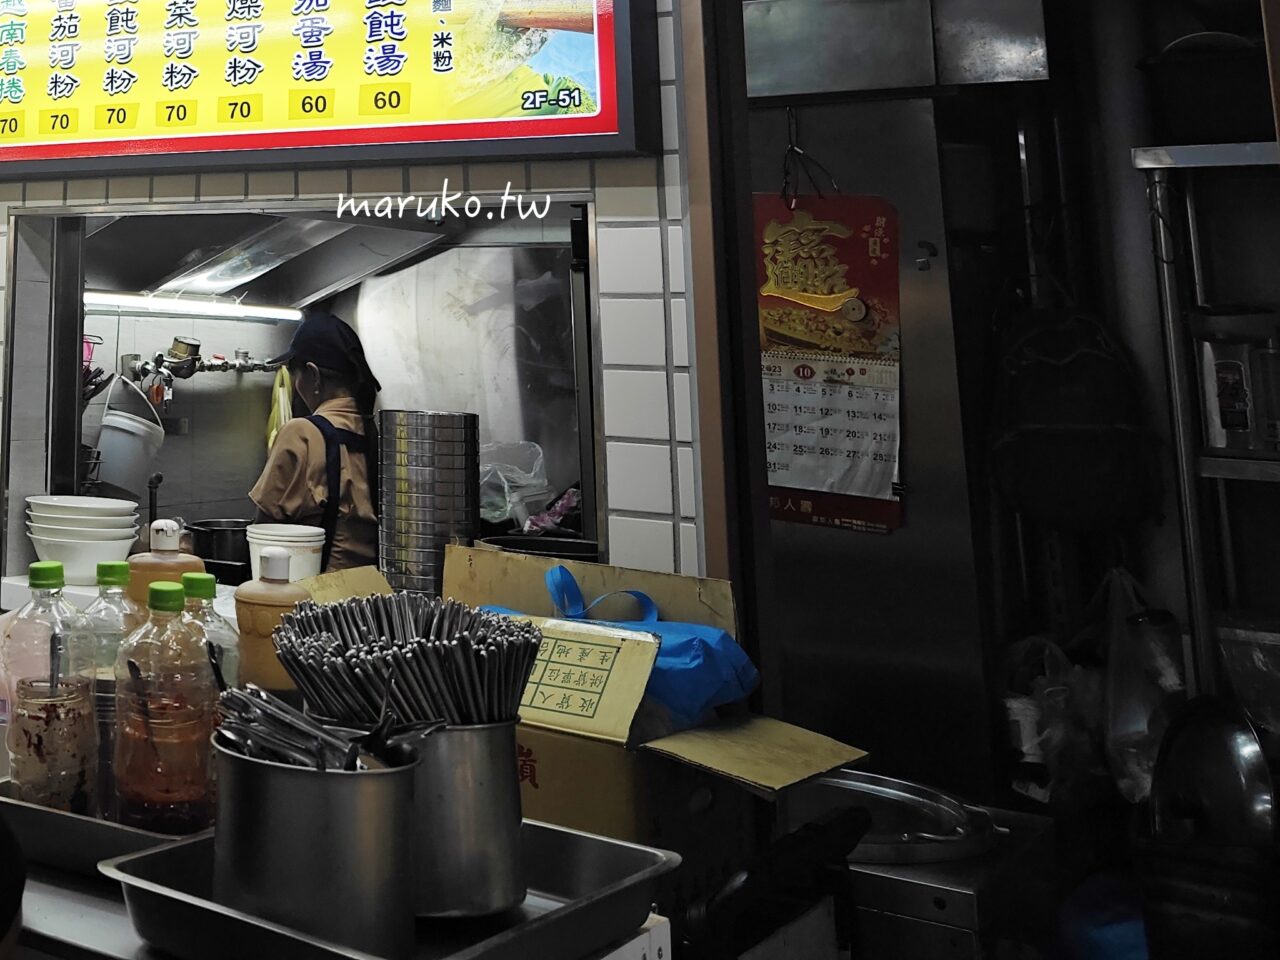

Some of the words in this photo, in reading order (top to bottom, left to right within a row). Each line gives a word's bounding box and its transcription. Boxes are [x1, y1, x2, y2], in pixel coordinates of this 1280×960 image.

[301, 96, 326, 114] 60
[374, 90, 400, 109] 60
[522, 89, 581, 110] 2F-51
[107, 108, 126, 125] 70
[166, 105, 187, 122] 70
[228, 101, 251, 119] 70
[0, 117, 18, 134] 70
[50, 114, 69, 131] 70
[556, 644, 613, 666] 生產地
[548, 669, 605, 688] 供貨單位
[539, 690, 595, 713] 收貨人
